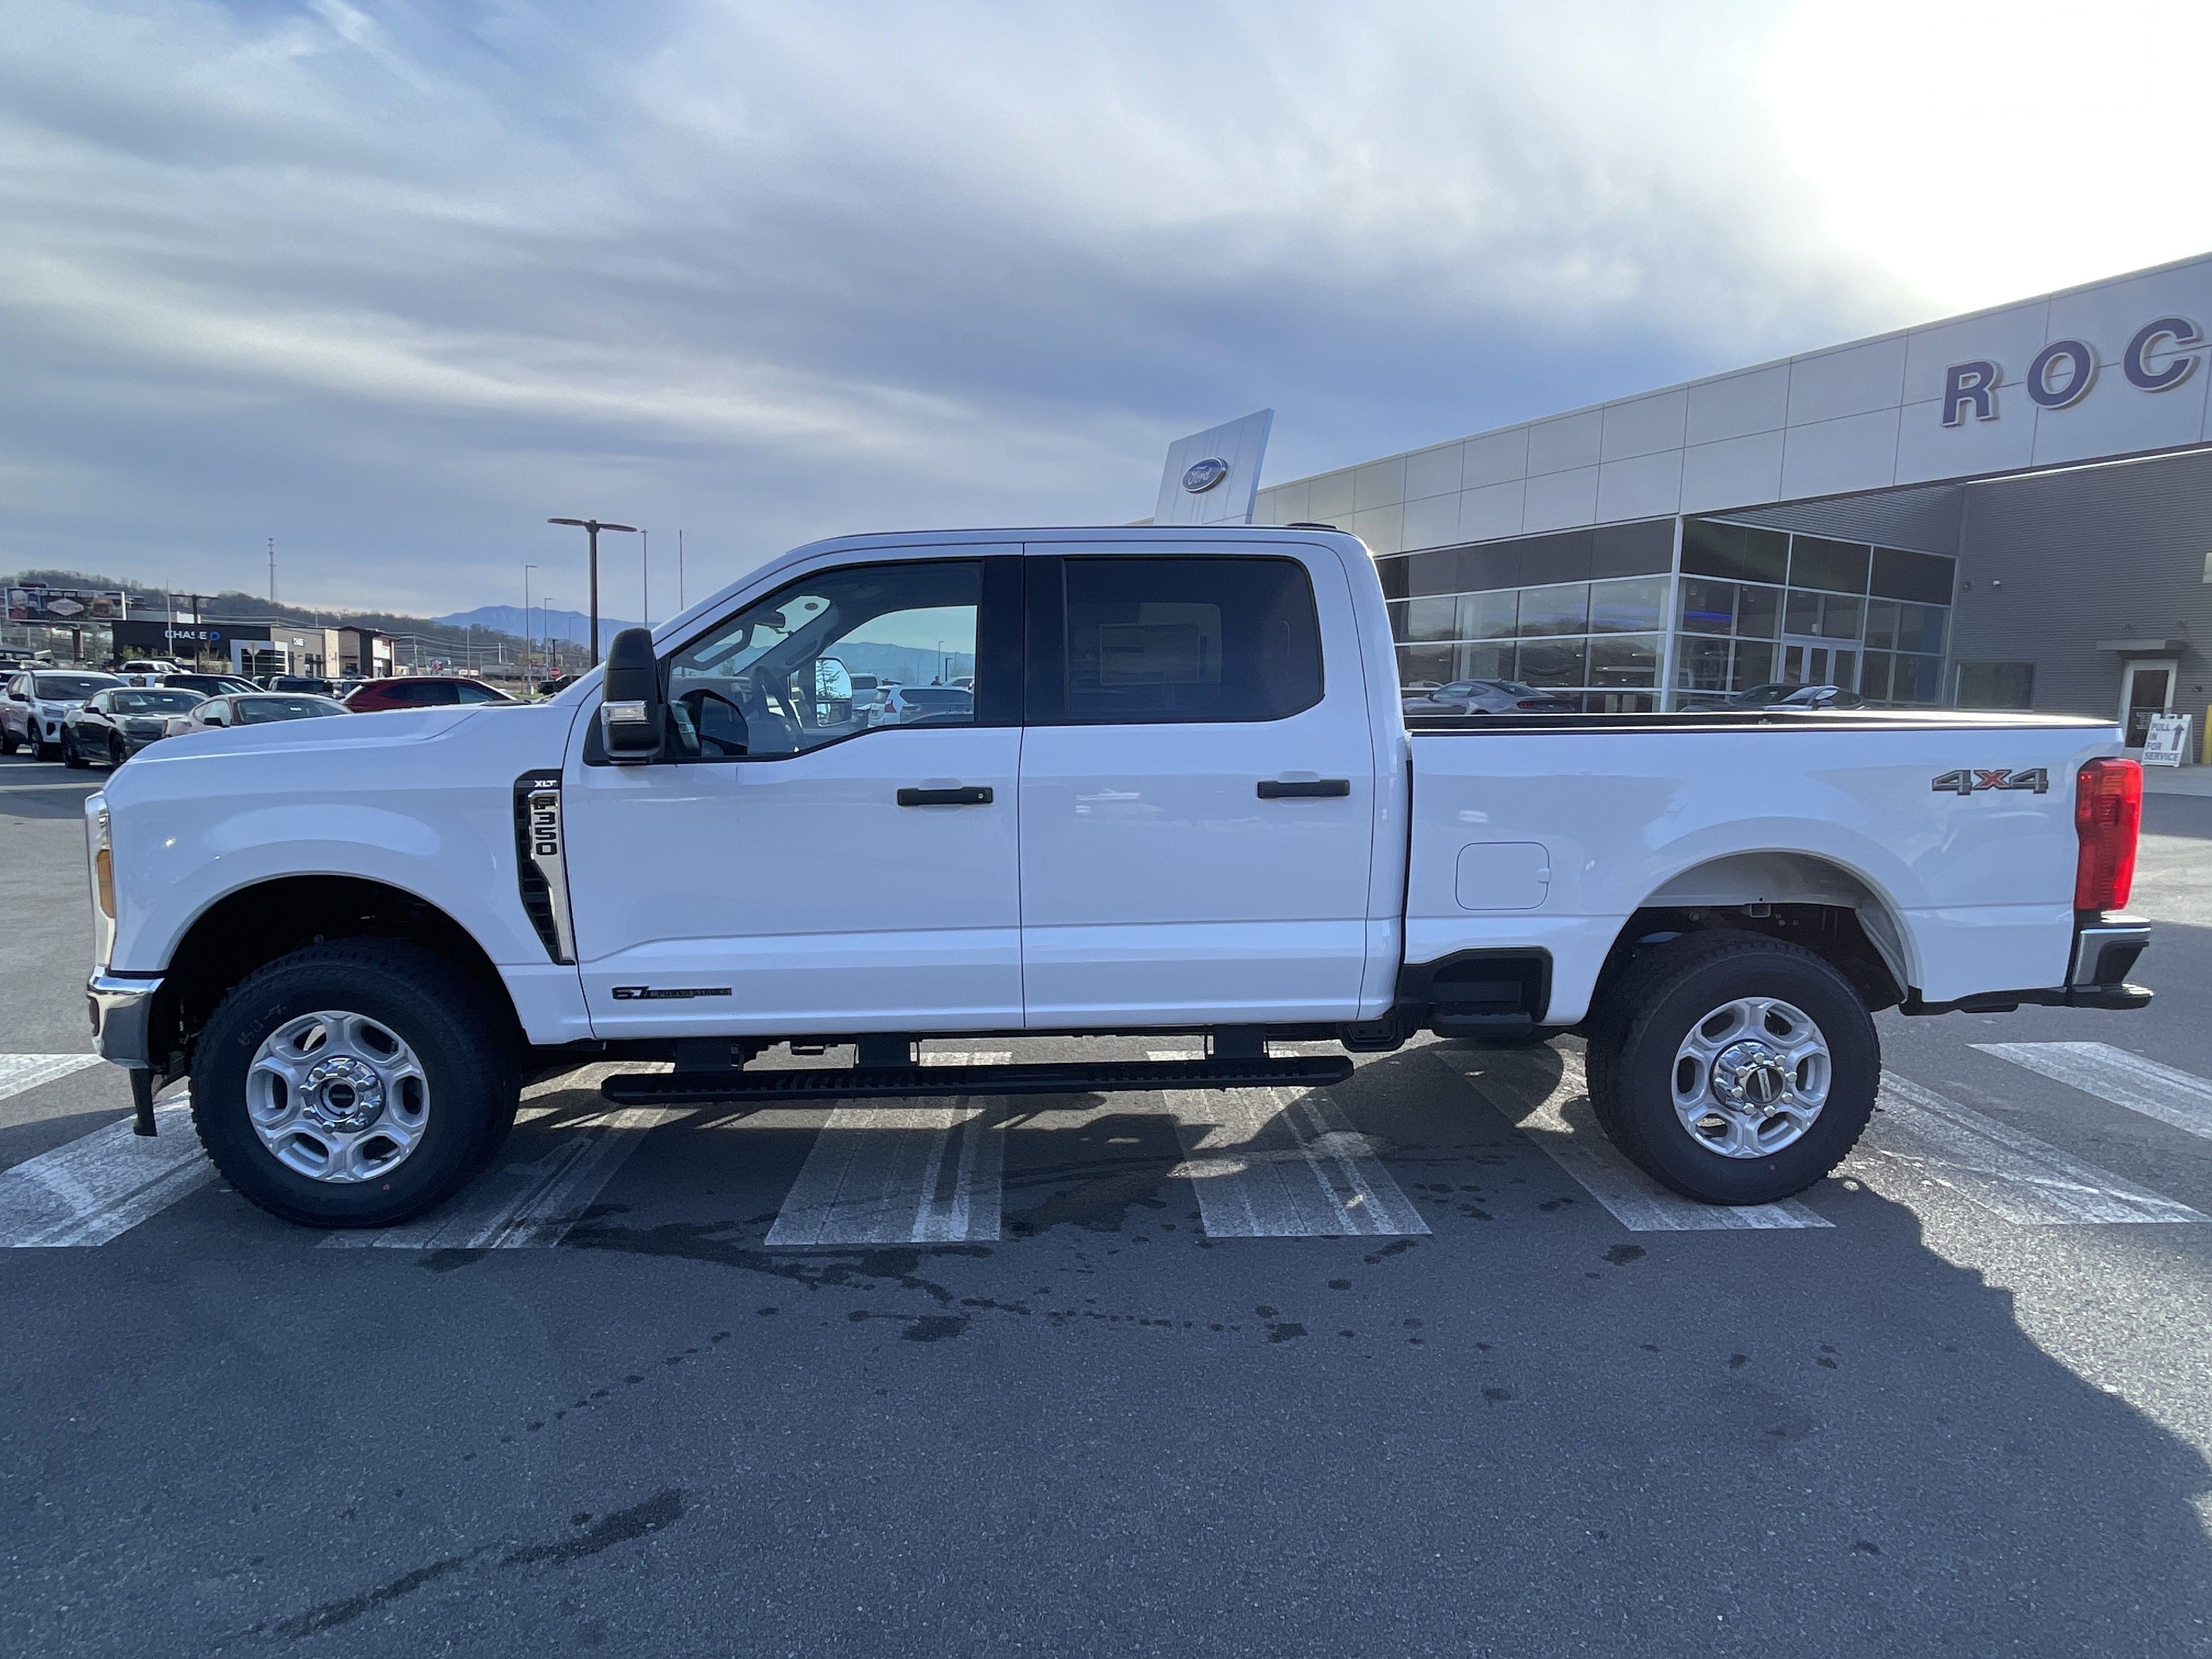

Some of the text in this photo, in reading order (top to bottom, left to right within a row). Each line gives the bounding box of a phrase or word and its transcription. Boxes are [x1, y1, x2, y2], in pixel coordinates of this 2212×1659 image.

[1940, 314, 2202, 427] ROC
[1187, 465, 1210, 484] Ford
[2151, 723, 2171, 732] PULL
[2146, 742, 2162, 751] FOR
[2143, 752, 2180, 761] SERVICE
